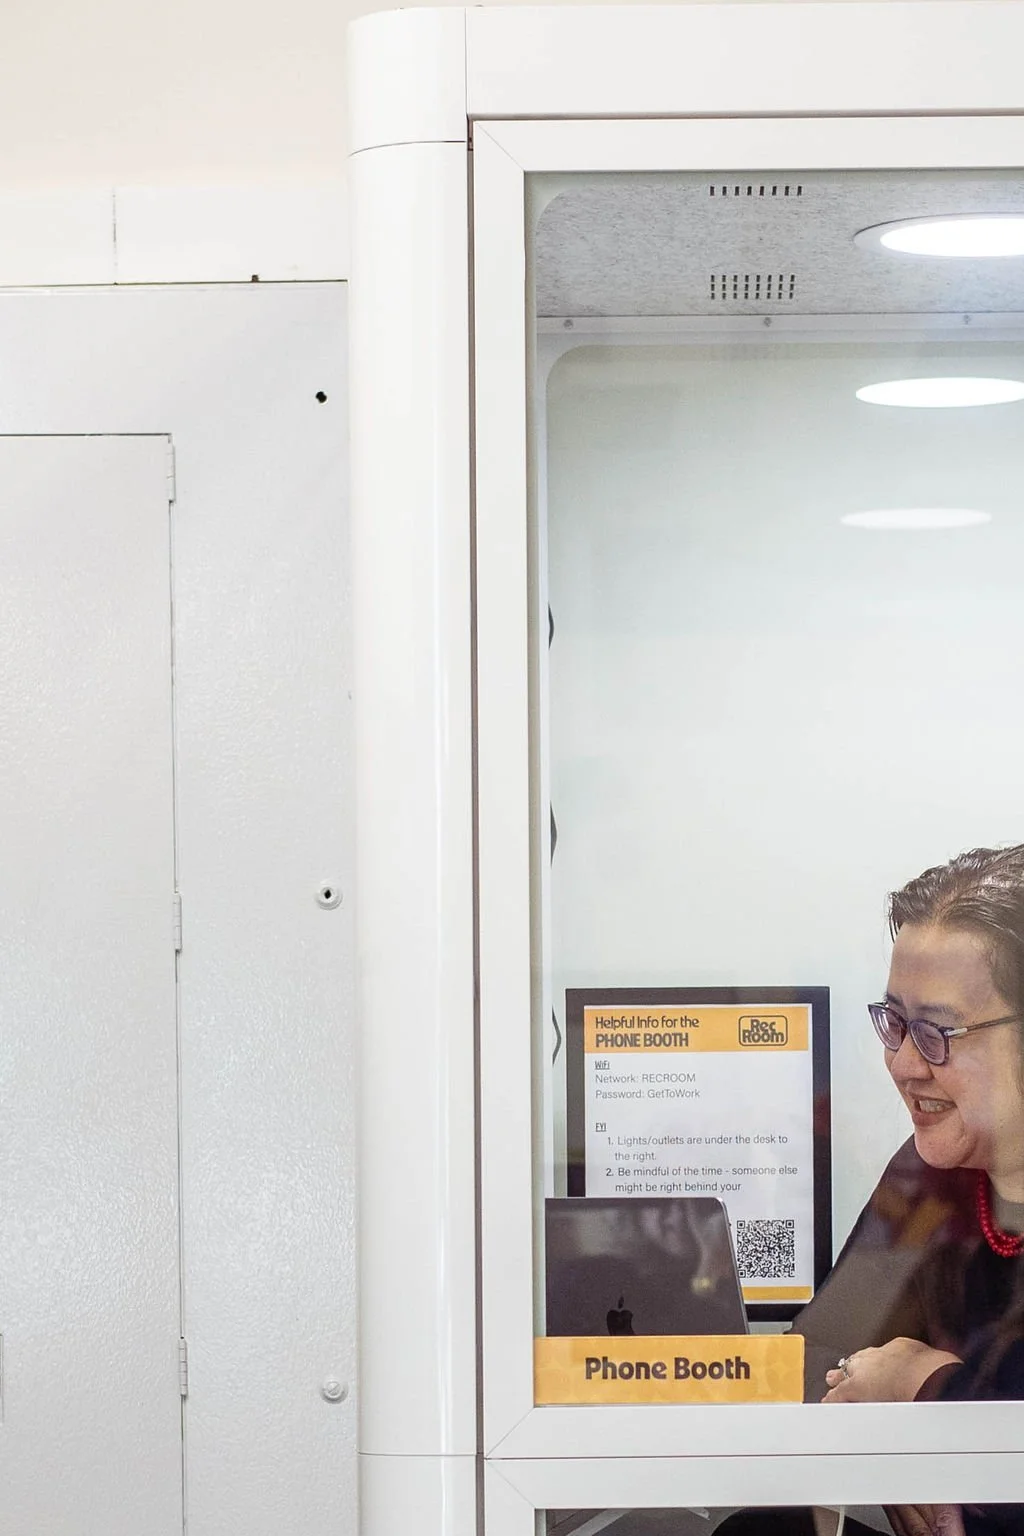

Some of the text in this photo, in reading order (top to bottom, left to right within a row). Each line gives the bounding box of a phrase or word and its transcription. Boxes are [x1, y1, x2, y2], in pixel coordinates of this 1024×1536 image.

[595, 1015, 700, 1031] Helpful Info for the
[750, 1019, 777, 1032] Rec
[595, 1033, 689, 1048] PHONE BOOTH
[742, 1030, 785, 1043] Room
[595, 1073, 696, 1084] Network: RECROOM
[596, 1088, 700, 1100] Password: GetToWork
[595, 1123, 607, 1132] FYI
[608, 1135, 788, 1147] 1. Lights/outlets are under the desk to
[615, 1152, 656, 1163] the right.
[606, 1168, 614, 1177] 2.
[618, 1168, 631, 1176] Be
[634, 1167, 669, 1176] mindful
[672, 1167, 682, 1176] of
[684, 1167, 699, 1176] the
[702, 1167, 723, 1176] time
[732, 1167, 776, 1175] someone
[779, 1166, 798, 1175] else
[615, 1182, 742, 1194] might be right behind your
[585, 1356, 751, 1380] Phone Booth
